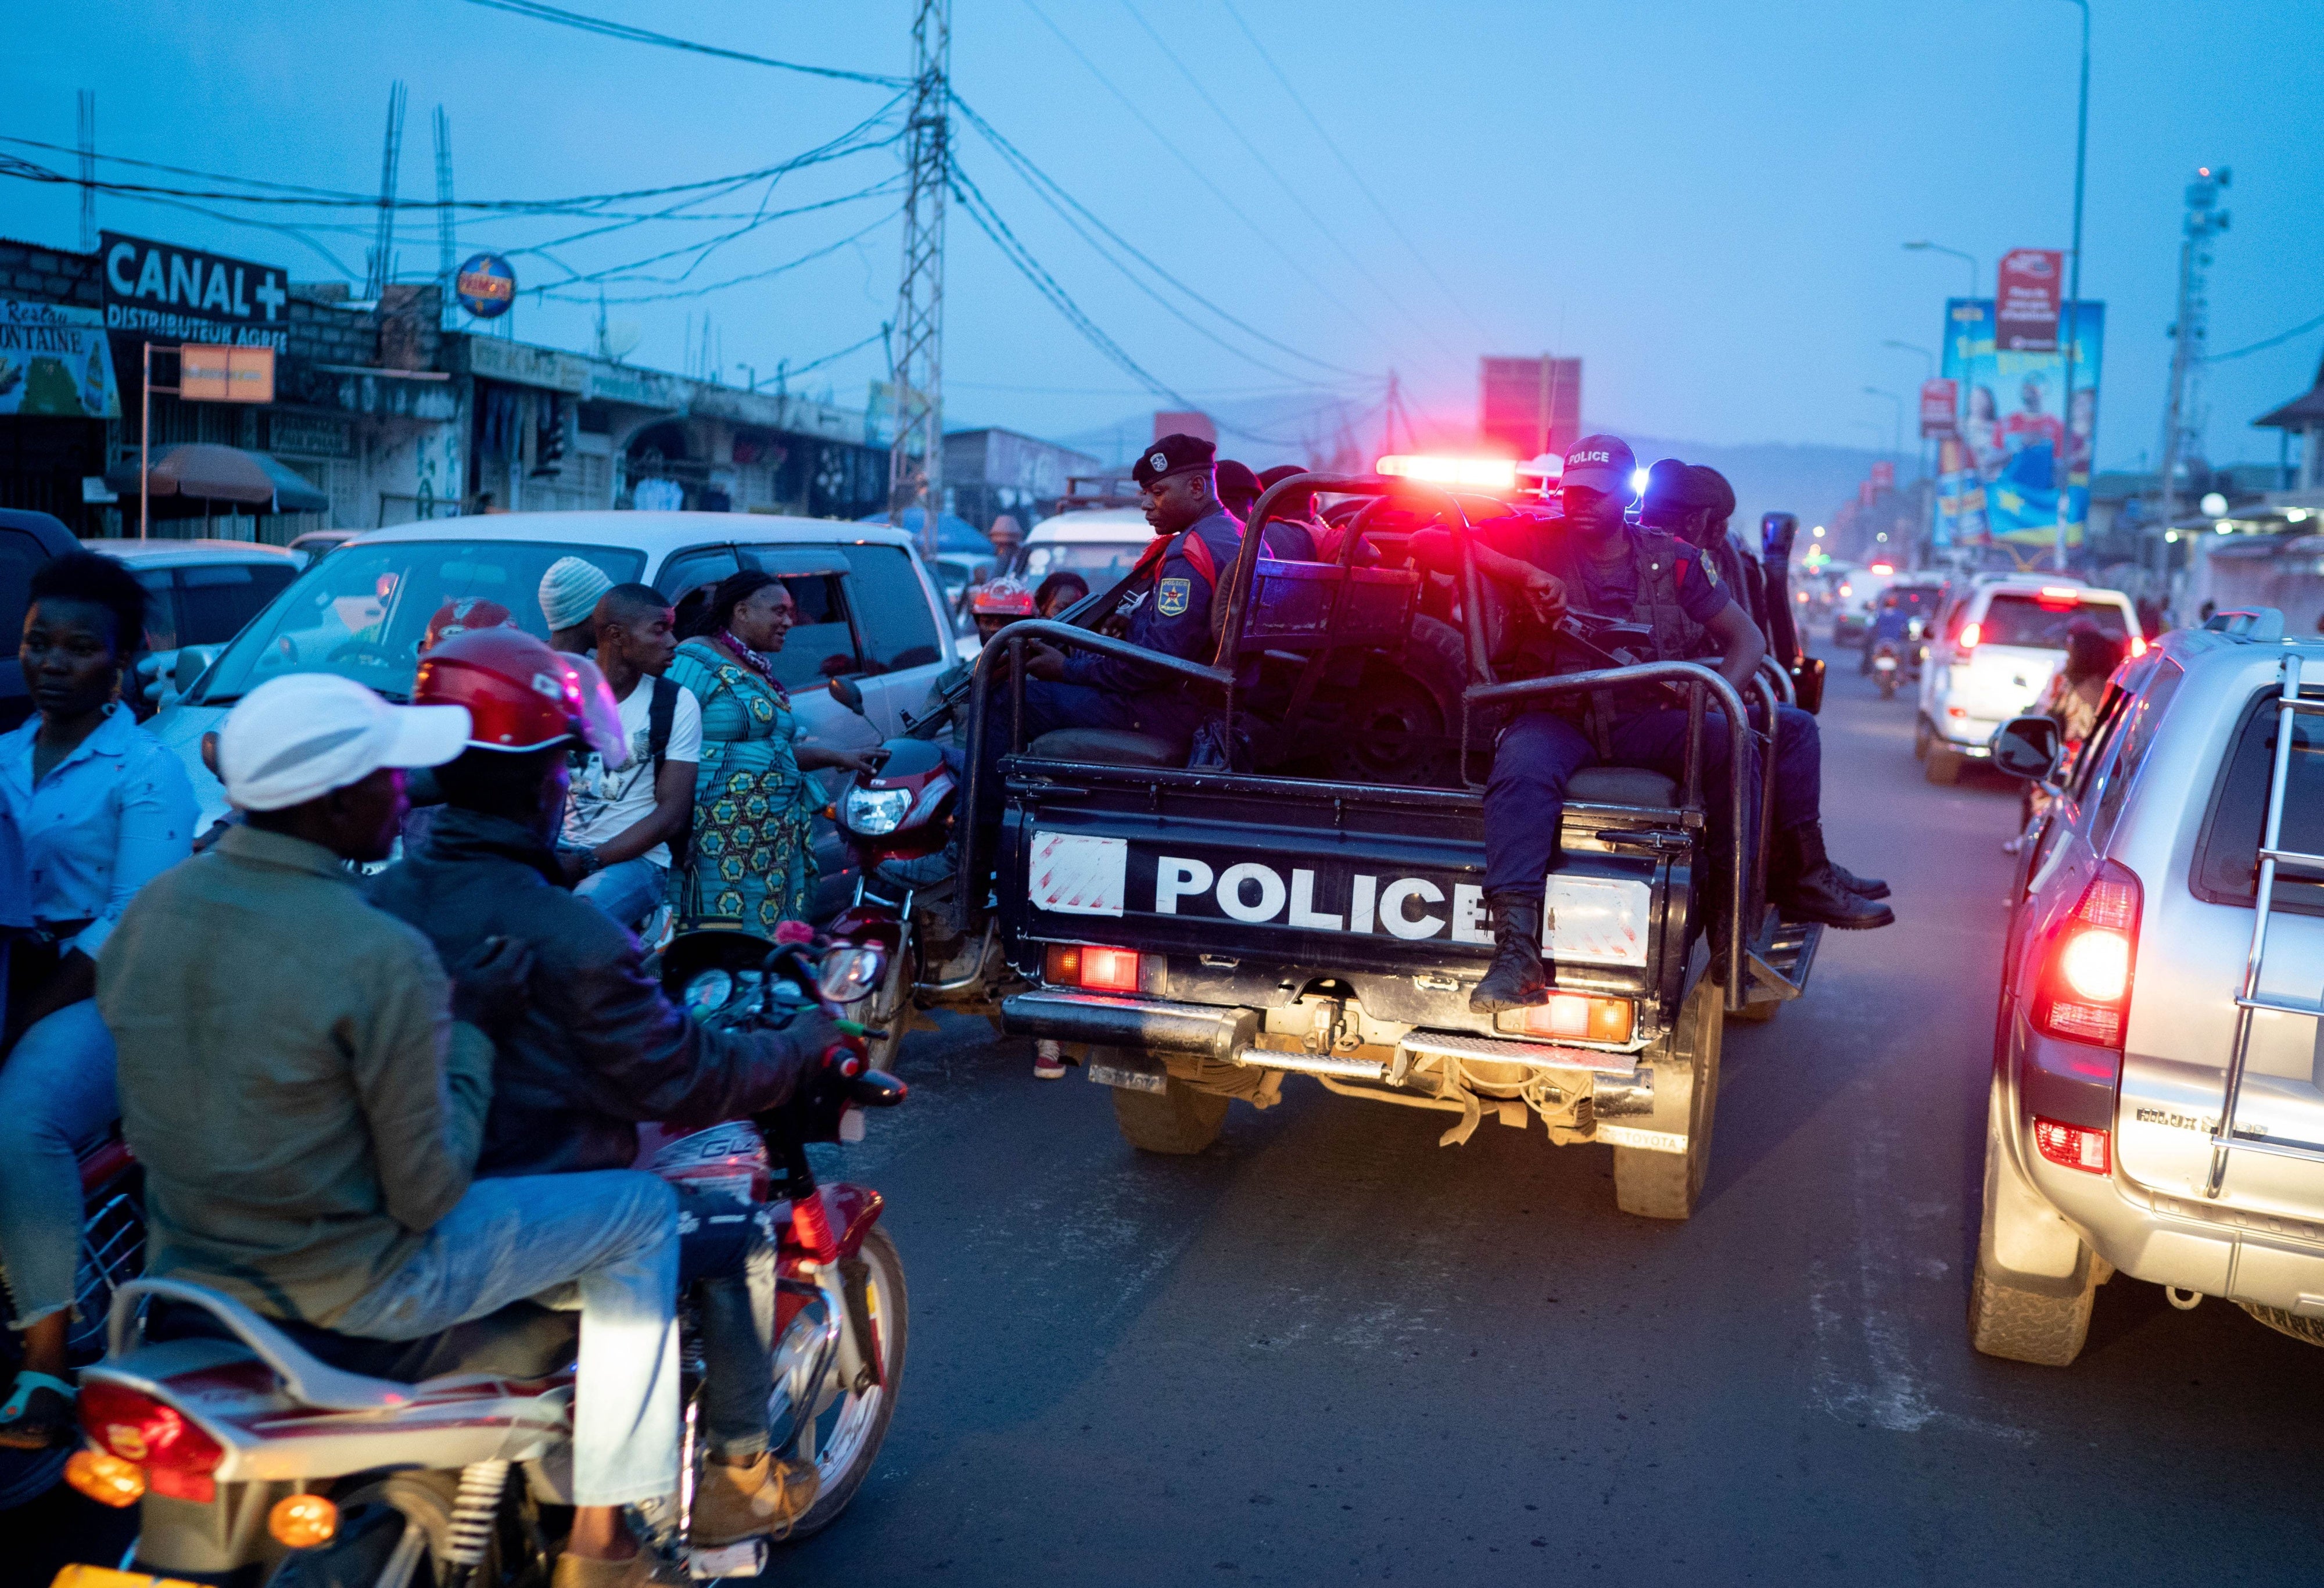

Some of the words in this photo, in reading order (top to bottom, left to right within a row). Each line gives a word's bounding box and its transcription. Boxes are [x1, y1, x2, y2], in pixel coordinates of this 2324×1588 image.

[107, 242, 286, 321] CANAL+
[107, 303, 232, 345] DISTRIBUTEUR
[1568, 451, 1609, 465] POLICE
[1156, 856, 1495, 946] POLICE
[2137, 1107, 2197, 1131] HILUX
[1626, 1134, 1676, 1149] TOYOTA
